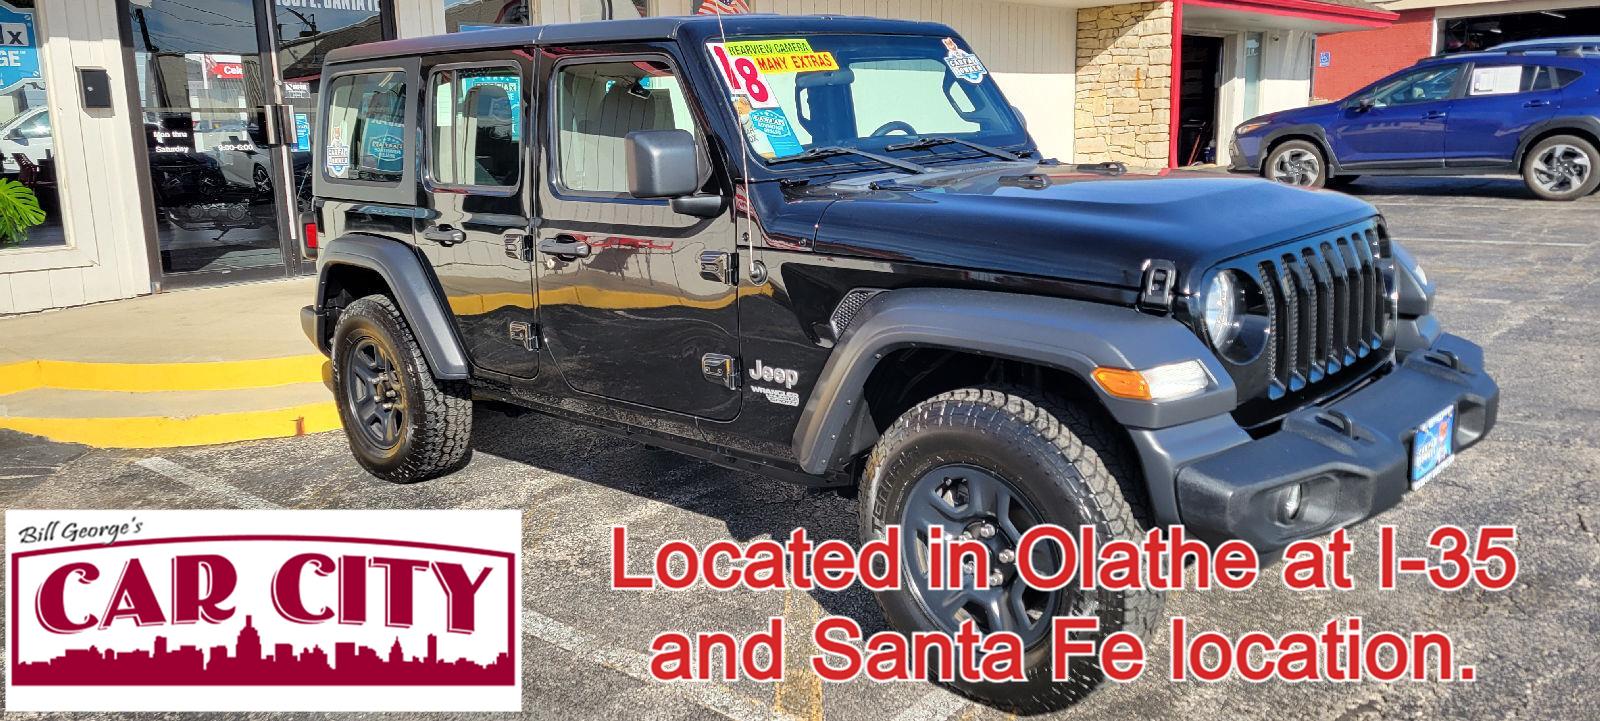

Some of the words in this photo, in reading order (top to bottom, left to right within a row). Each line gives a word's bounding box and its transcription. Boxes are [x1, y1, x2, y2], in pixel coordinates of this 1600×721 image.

[728, 45, 773, 56] REARVIEW
[773, 42, 809, 54] CAMERA
[756, 57, 788, 71] MANY
[790, 53, 833, 69] EXTRAS
[714, 46, 768, 102] 18
[155, 145, 189, 154] Saturday
[748, 360, 799, 390] Jeep
